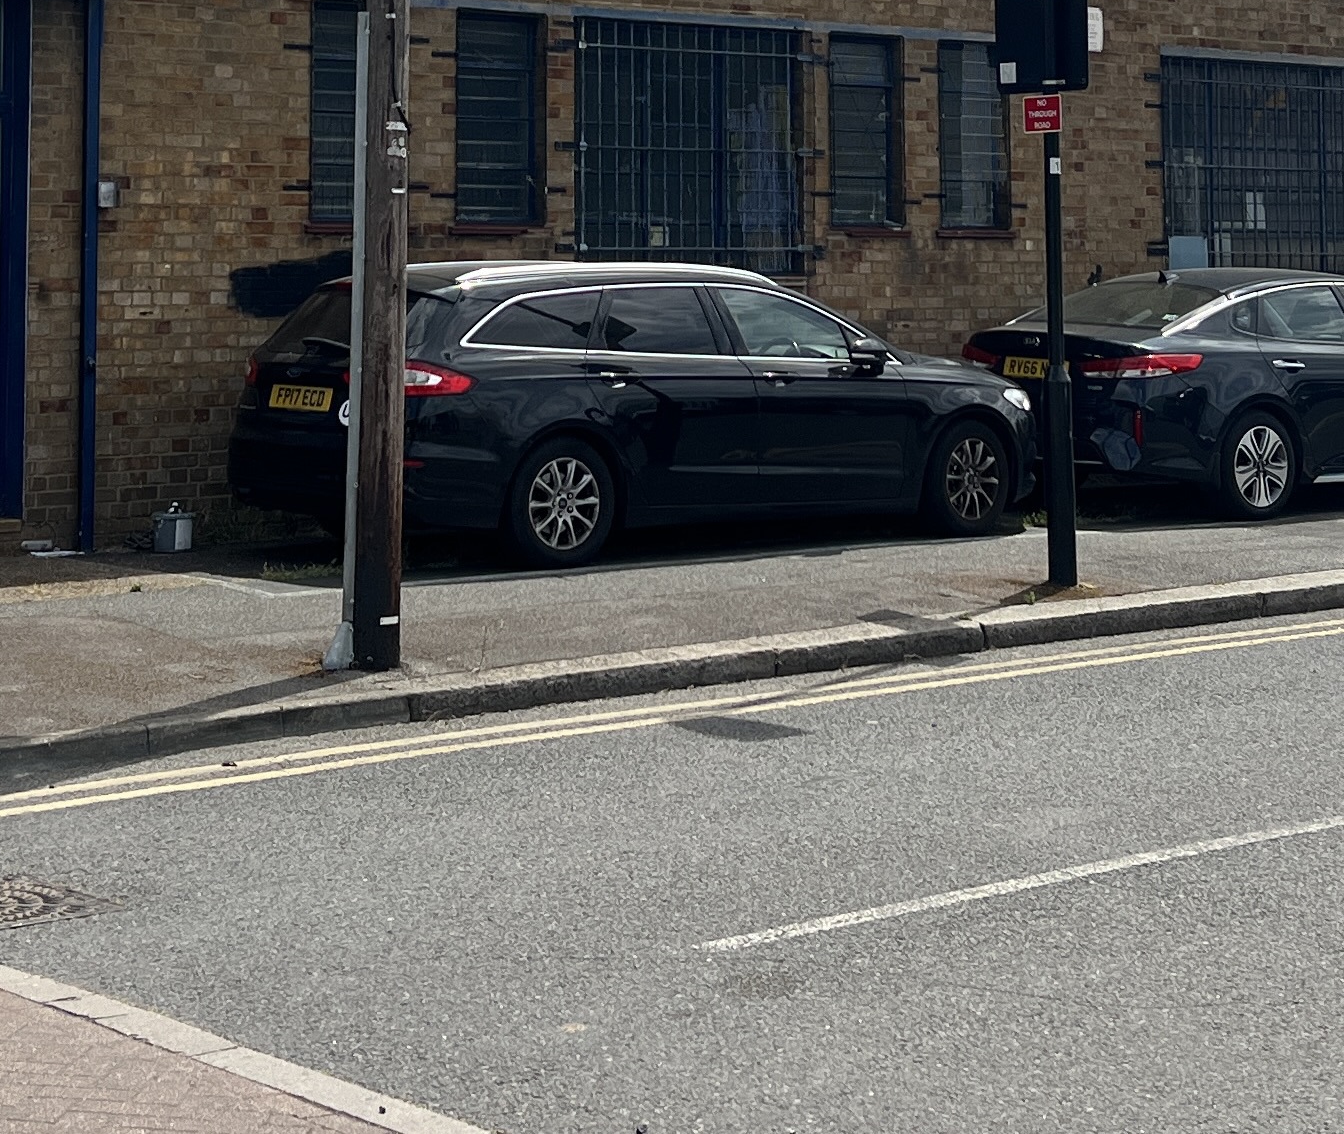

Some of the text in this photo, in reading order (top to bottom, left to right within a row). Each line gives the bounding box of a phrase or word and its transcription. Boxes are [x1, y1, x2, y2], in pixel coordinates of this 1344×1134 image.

[1028, 110, 1057, 119] THROUGH
[1034, 121, 1051, 129] ROAD
[1008, 359, 1039, 376] RV66
[276, 387, 326, 407] FP17 ECD
